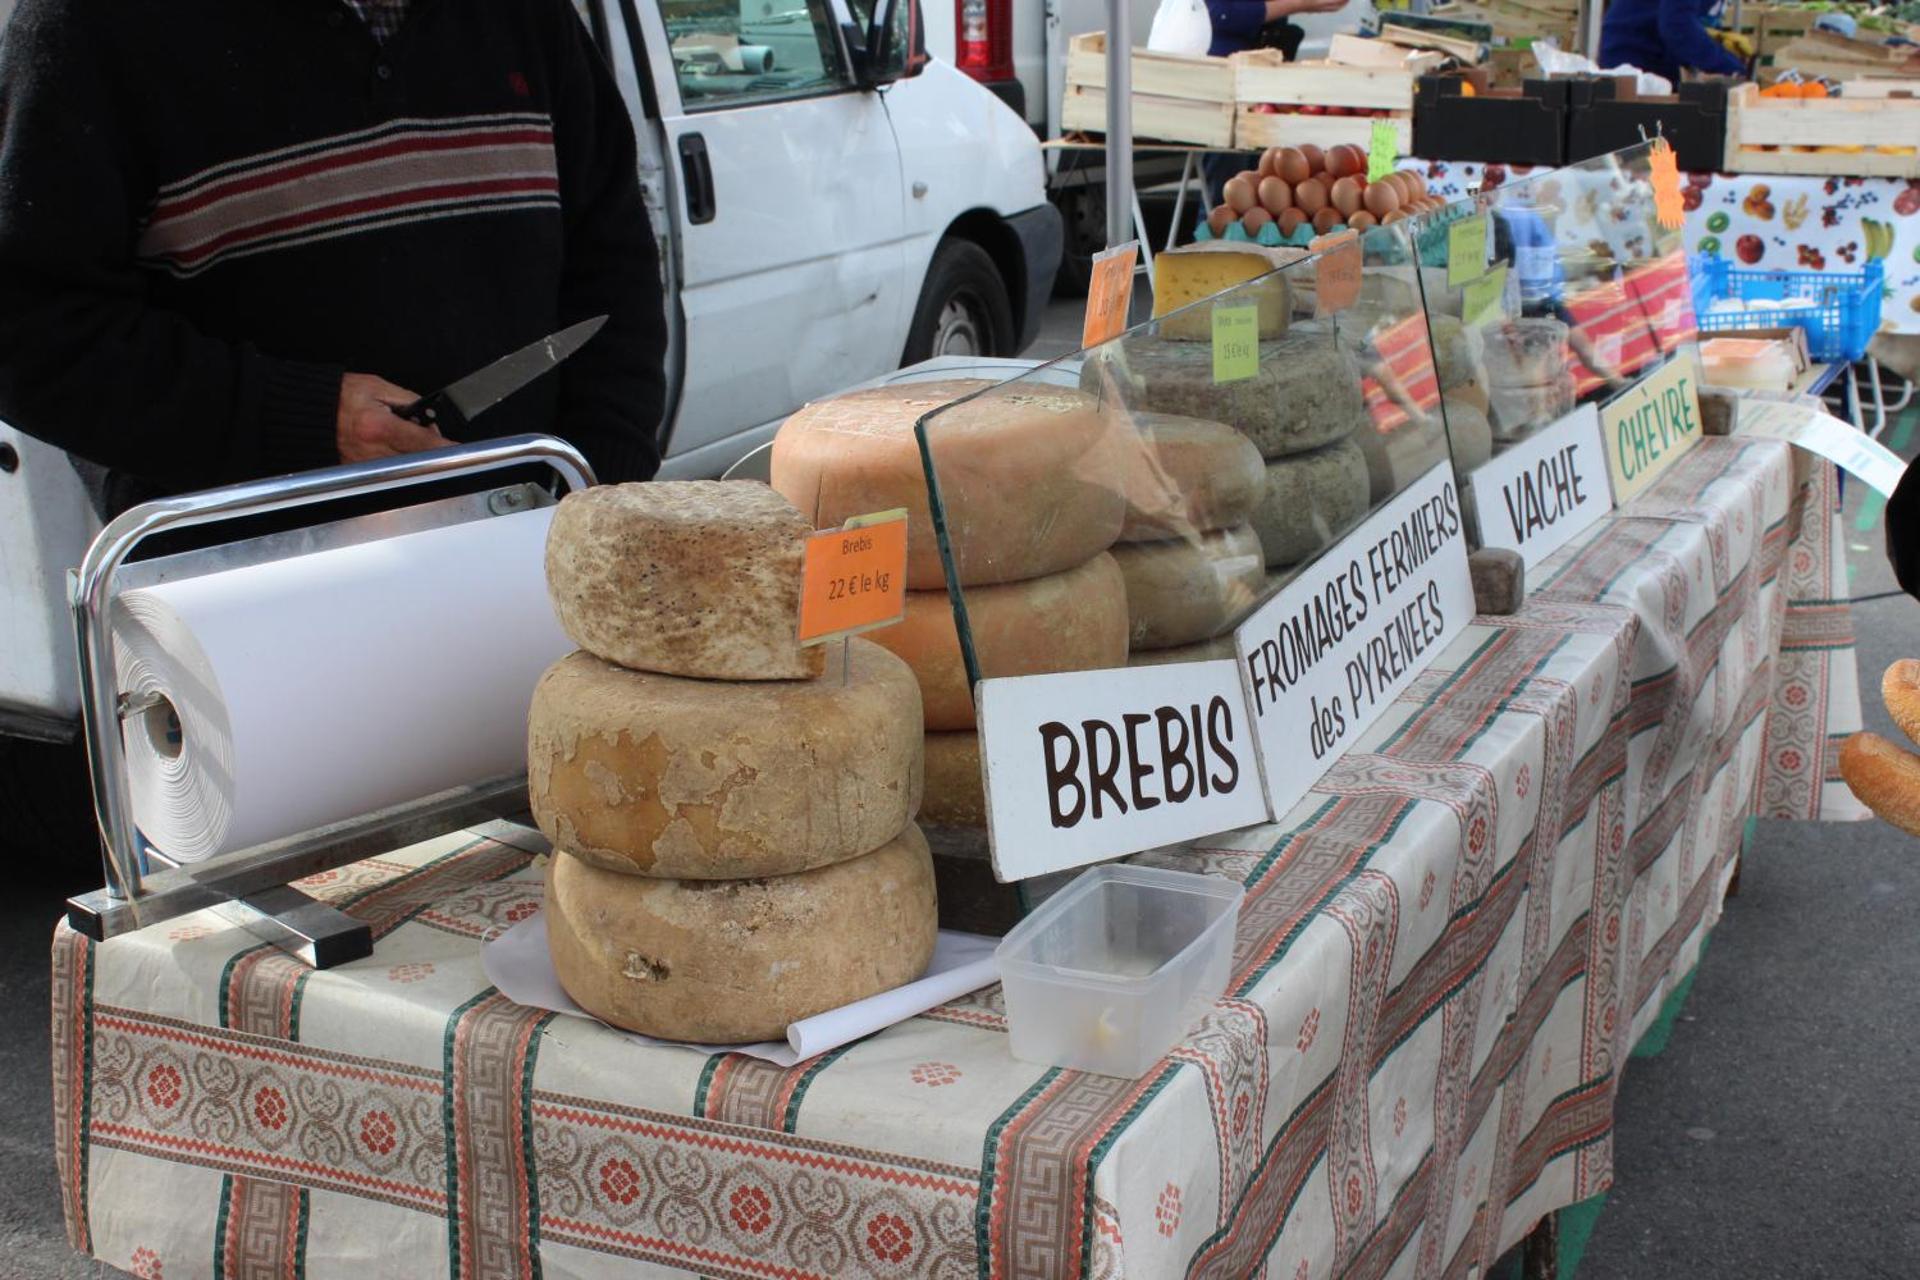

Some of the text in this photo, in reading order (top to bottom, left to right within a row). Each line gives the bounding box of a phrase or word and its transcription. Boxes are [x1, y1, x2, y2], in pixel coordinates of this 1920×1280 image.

[1618, 378, 1694, 481] CHÈVRE
[841, 535, 873, 555] Brebis
[1503, 443, 1587, 545] VACHE
[860, 573, 872, 592] le
[875, 568, 890, 593] kg
[1247, 481, 1459, 717] FROMAGES FERMIERS
[1309, 579, 1445, 760] des PYRENEES
[1038, 695, 1239, 828] BREBIS
